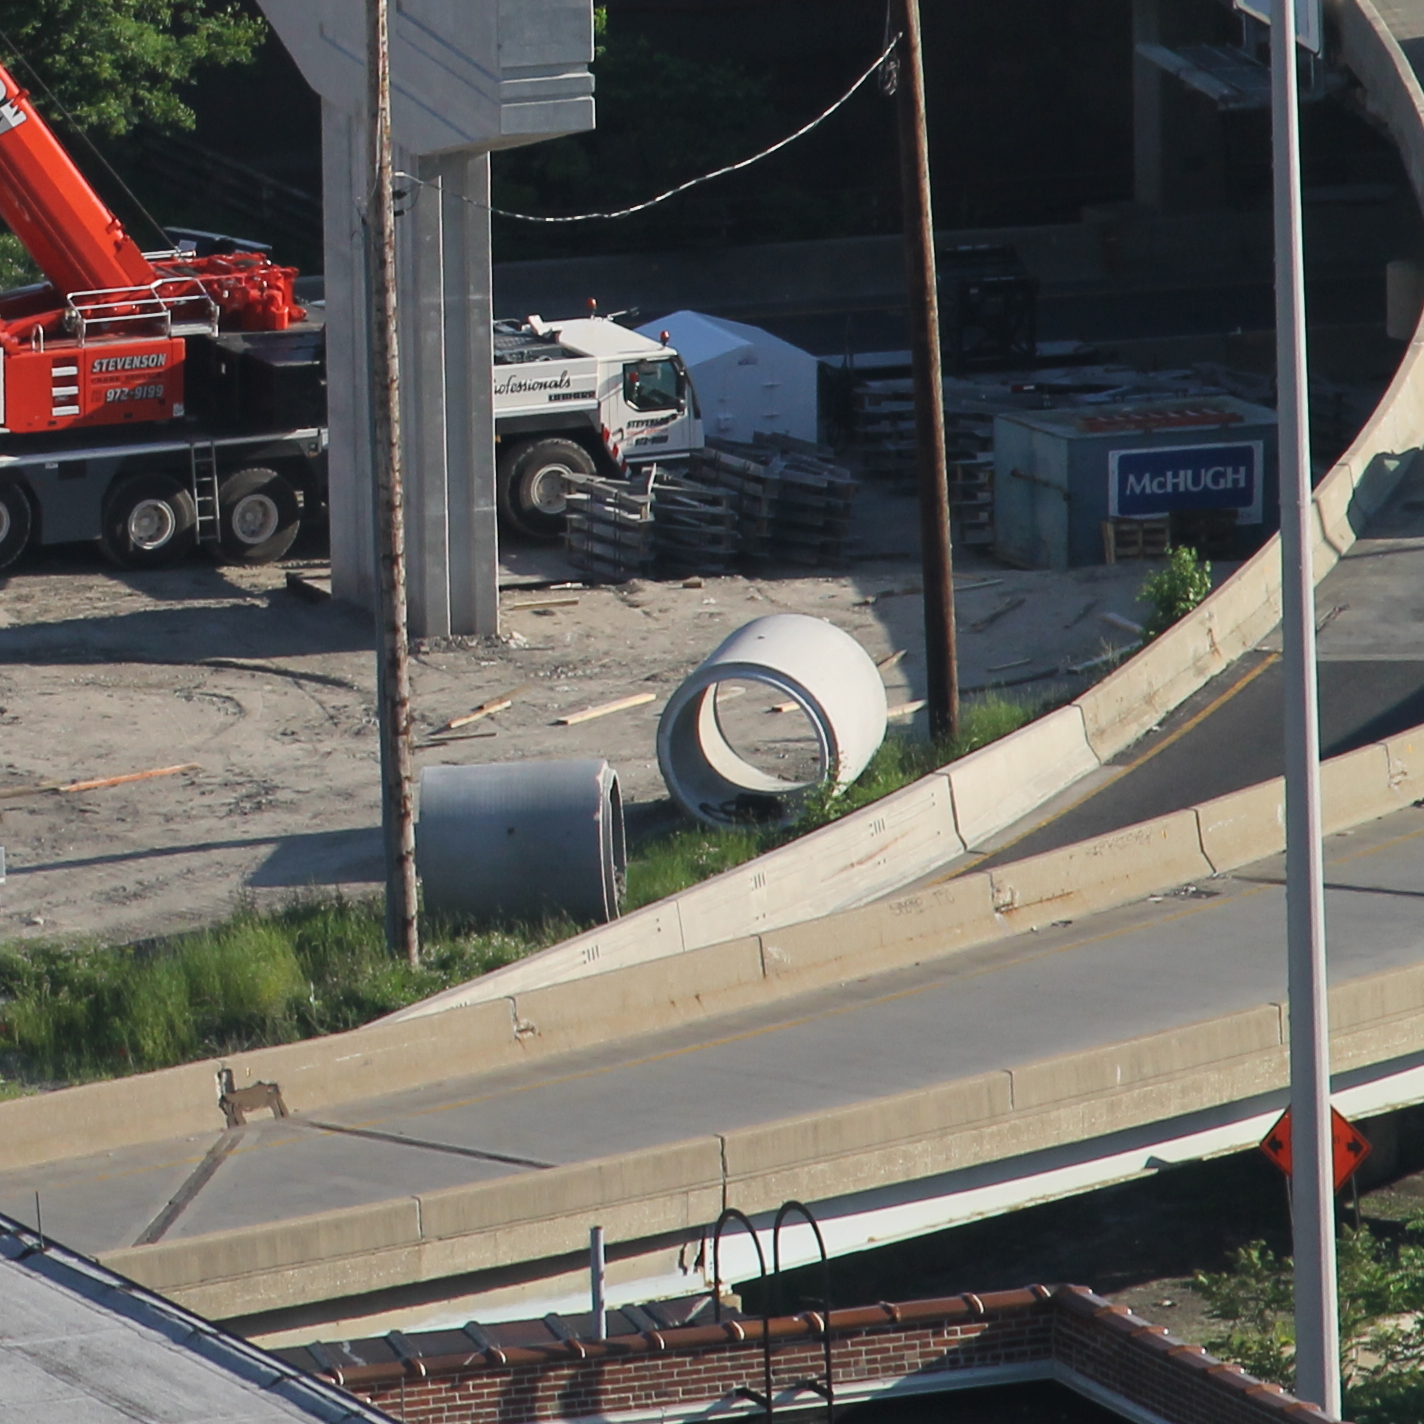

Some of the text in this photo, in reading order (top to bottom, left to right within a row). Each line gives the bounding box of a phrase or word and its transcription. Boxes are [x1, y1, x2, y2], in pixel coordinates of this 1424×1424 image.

[92, 353, 167, 373] STEVENSON
[106, 384, 164, 403] 972-9199
[1126, 466, 1247, 495] McHUGH
